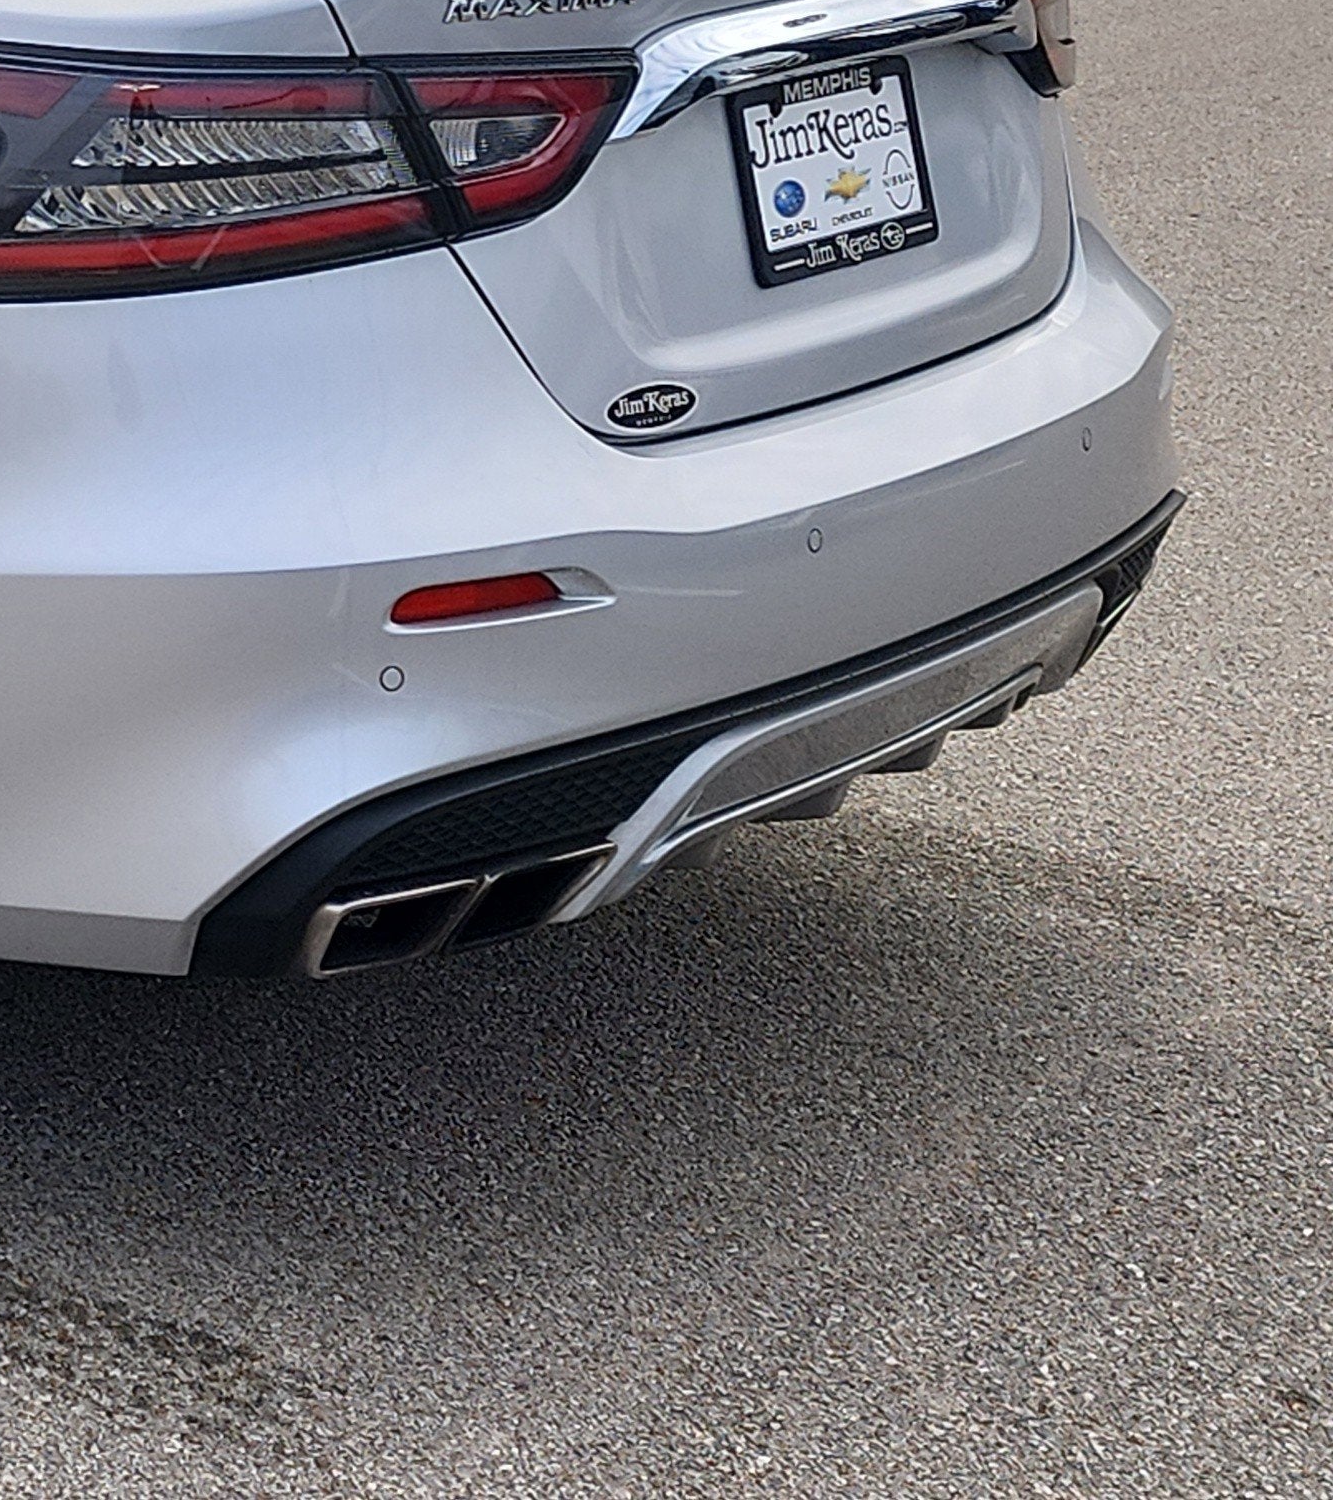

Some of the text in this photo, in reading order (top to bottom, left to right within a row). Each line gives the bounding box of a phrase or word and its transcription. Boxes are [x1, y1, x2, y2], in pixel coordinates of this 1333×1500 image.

[783, 66, 872, 104] MEMPHIS
[882, 172, 915, 188] NISSAN
[769, 216, 818, 243] SUBARU
[805, 232, 881, 268] Jim Keras
